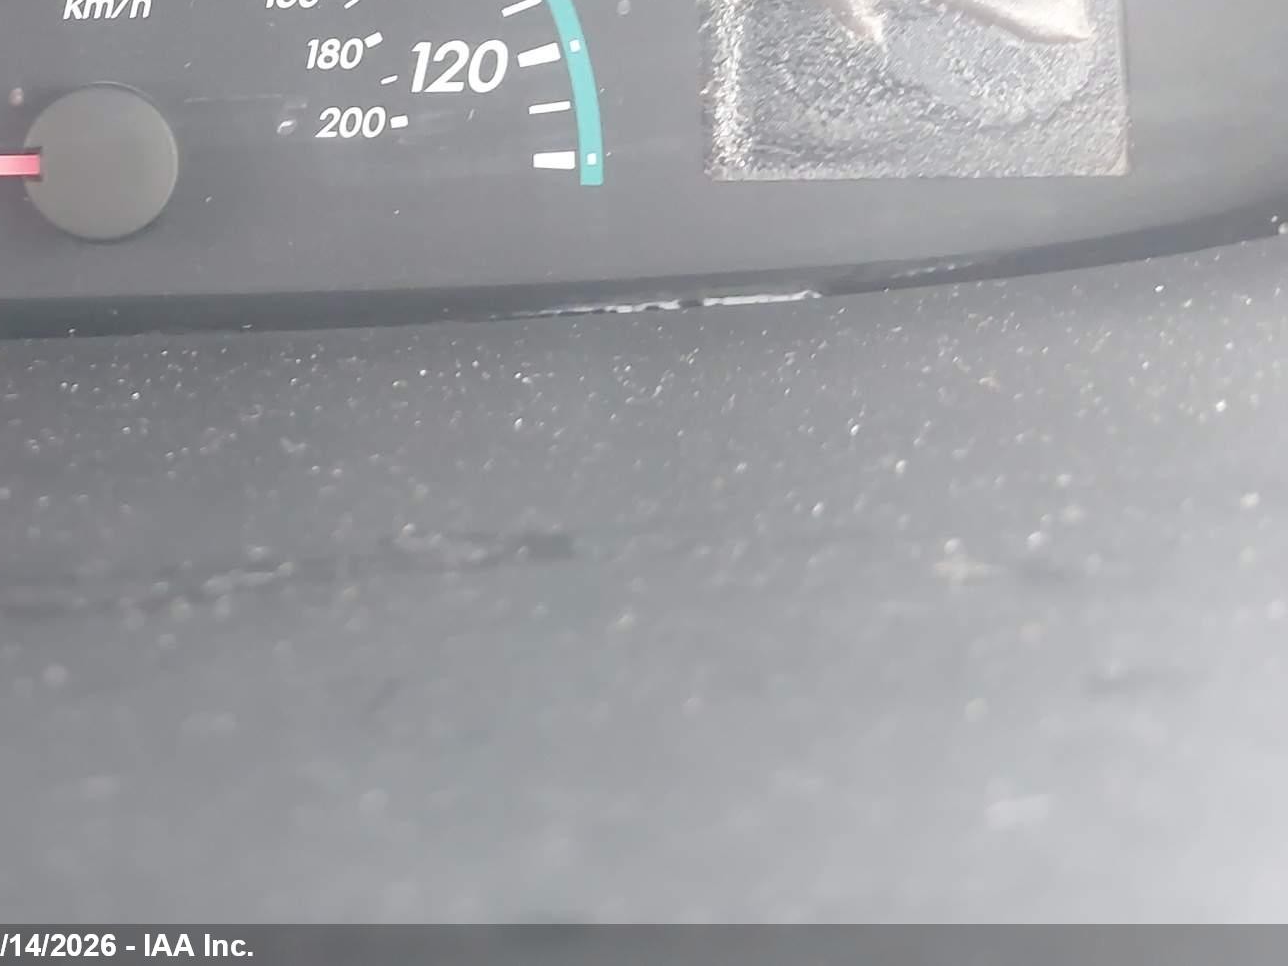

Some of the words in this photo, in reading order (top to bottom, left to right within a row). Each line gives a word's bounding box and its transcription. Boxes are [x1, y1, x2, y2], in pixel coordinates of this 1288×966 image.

[306, 38, 364, 69] 180
[411, 40, 509, 93] 120
[315, 107, 385, 139] 200
